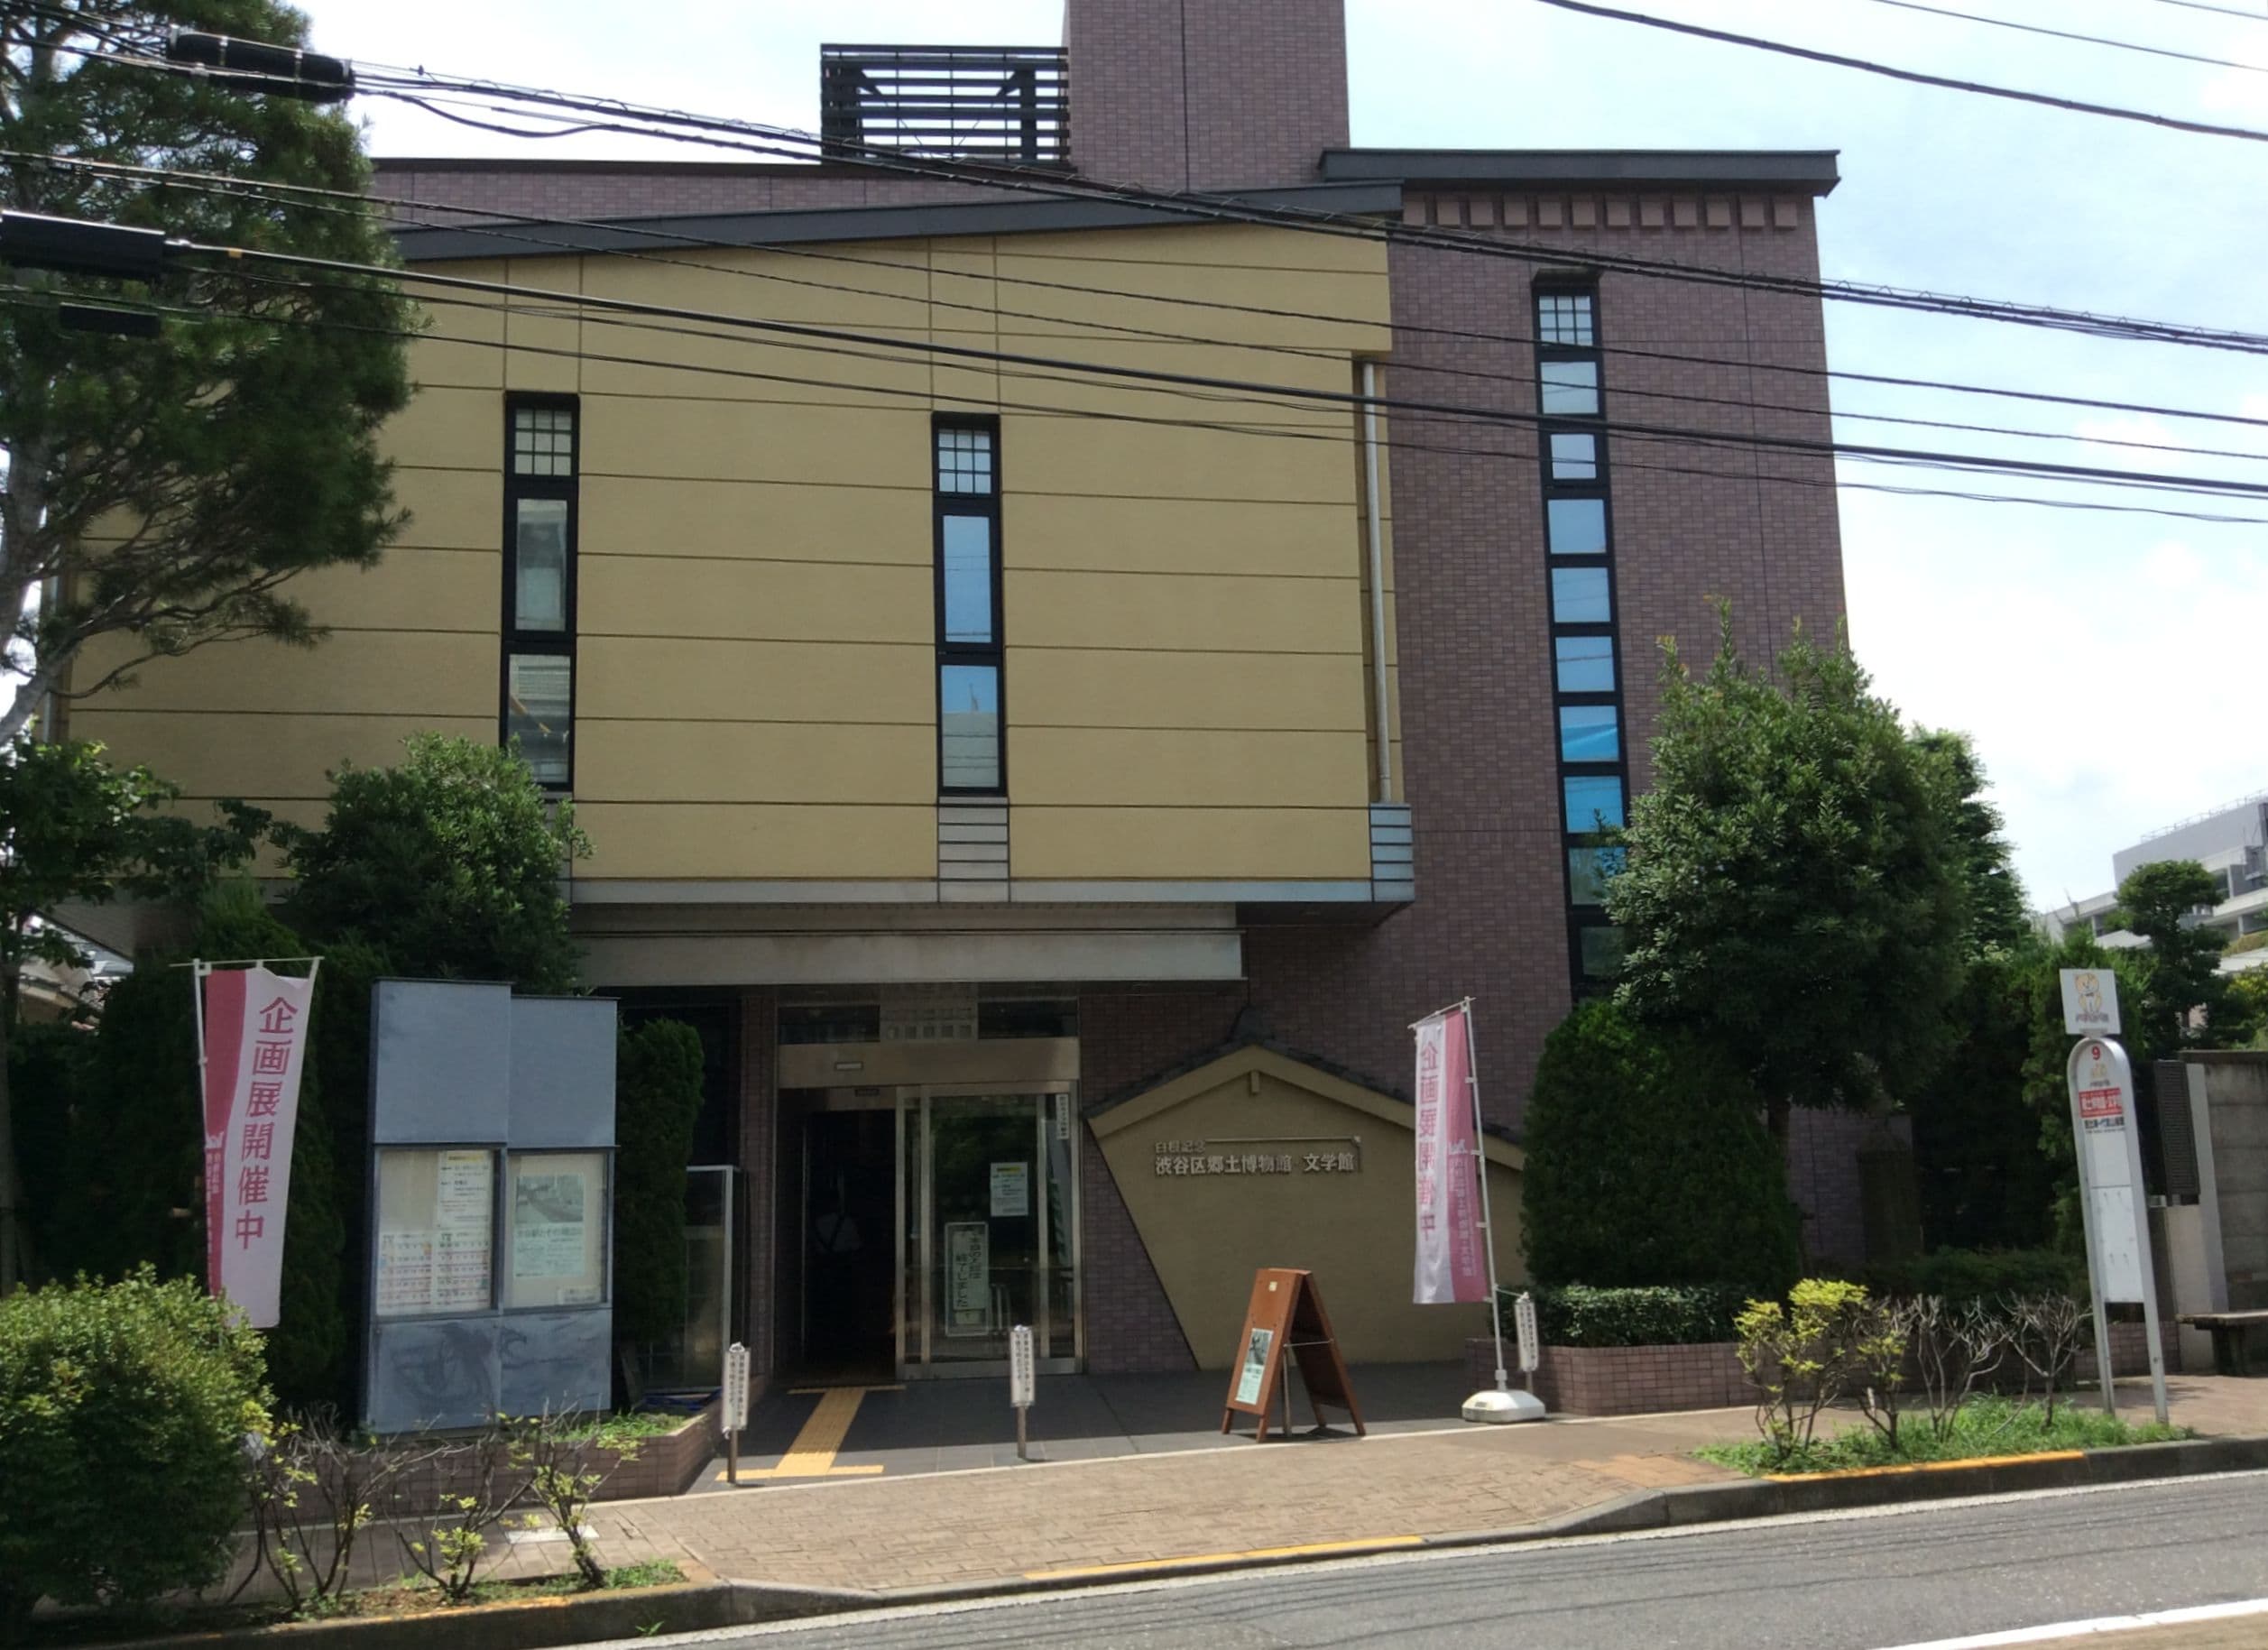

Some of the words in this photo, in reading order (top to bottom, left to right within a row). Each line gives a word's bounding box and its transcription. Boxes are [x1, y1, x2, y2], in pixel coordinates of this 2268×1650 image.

[2091, 1046, 2101, 1060] 9
[235, 996, 298, 1250] 企画展開催中
[1155, 1155, 1293, 1175] 渋谷区郷土博物館
[1303, 1153, 1355, 1172] 文学館
